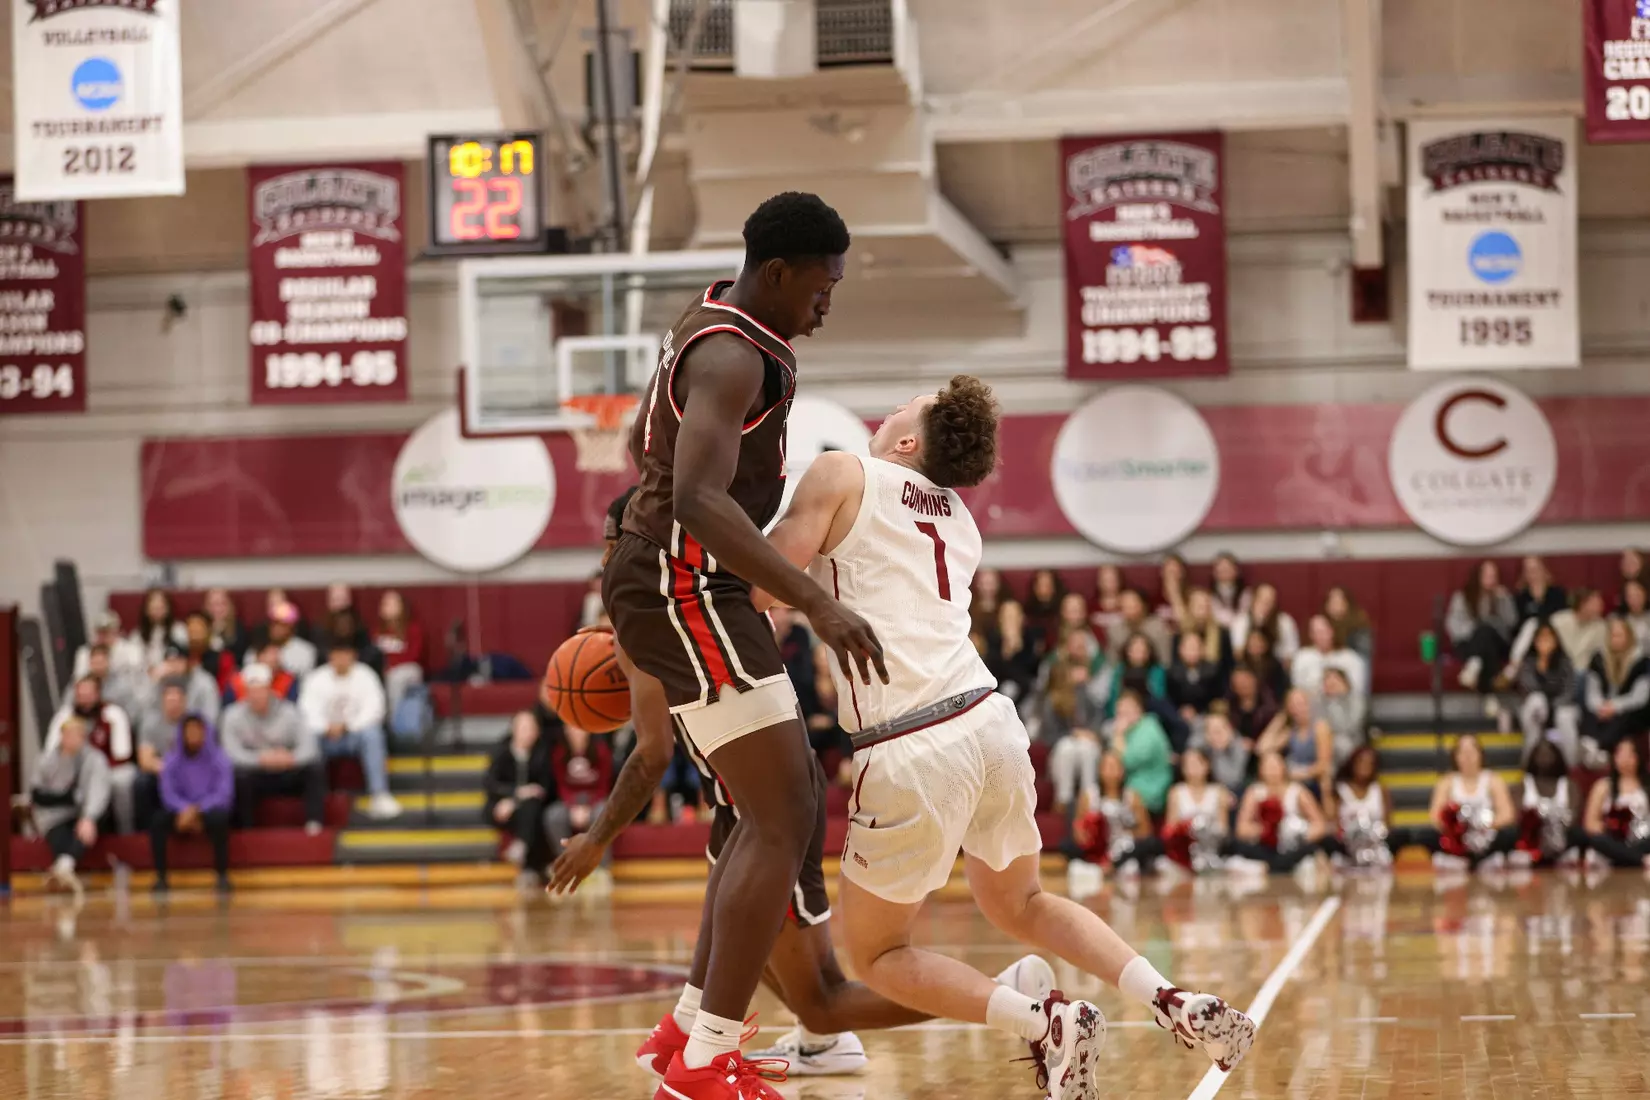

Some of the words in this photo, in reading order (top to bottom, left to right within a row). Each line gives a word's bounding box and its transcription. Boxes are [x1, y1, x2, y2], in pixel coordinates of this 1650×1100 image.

[32, 116, 164, 138] TOURNAMENT
[64, 144, 136, 175] 2012
[449, 177, 523, 240] 22
[1427, 290, 1561, 308] TOURNAMENT
[1081, 326, 1218, 363] 1994-95
[1460, 317, 1533, 345] 1995
[265, 351, 397, 388] 1994-95
[1434, 388, 1508, 460] C
[1410, 467, 1532, 492] COLGATE
[901, 481, 952, 517] CUMMINS
[914, 521, 951, 602] 1
